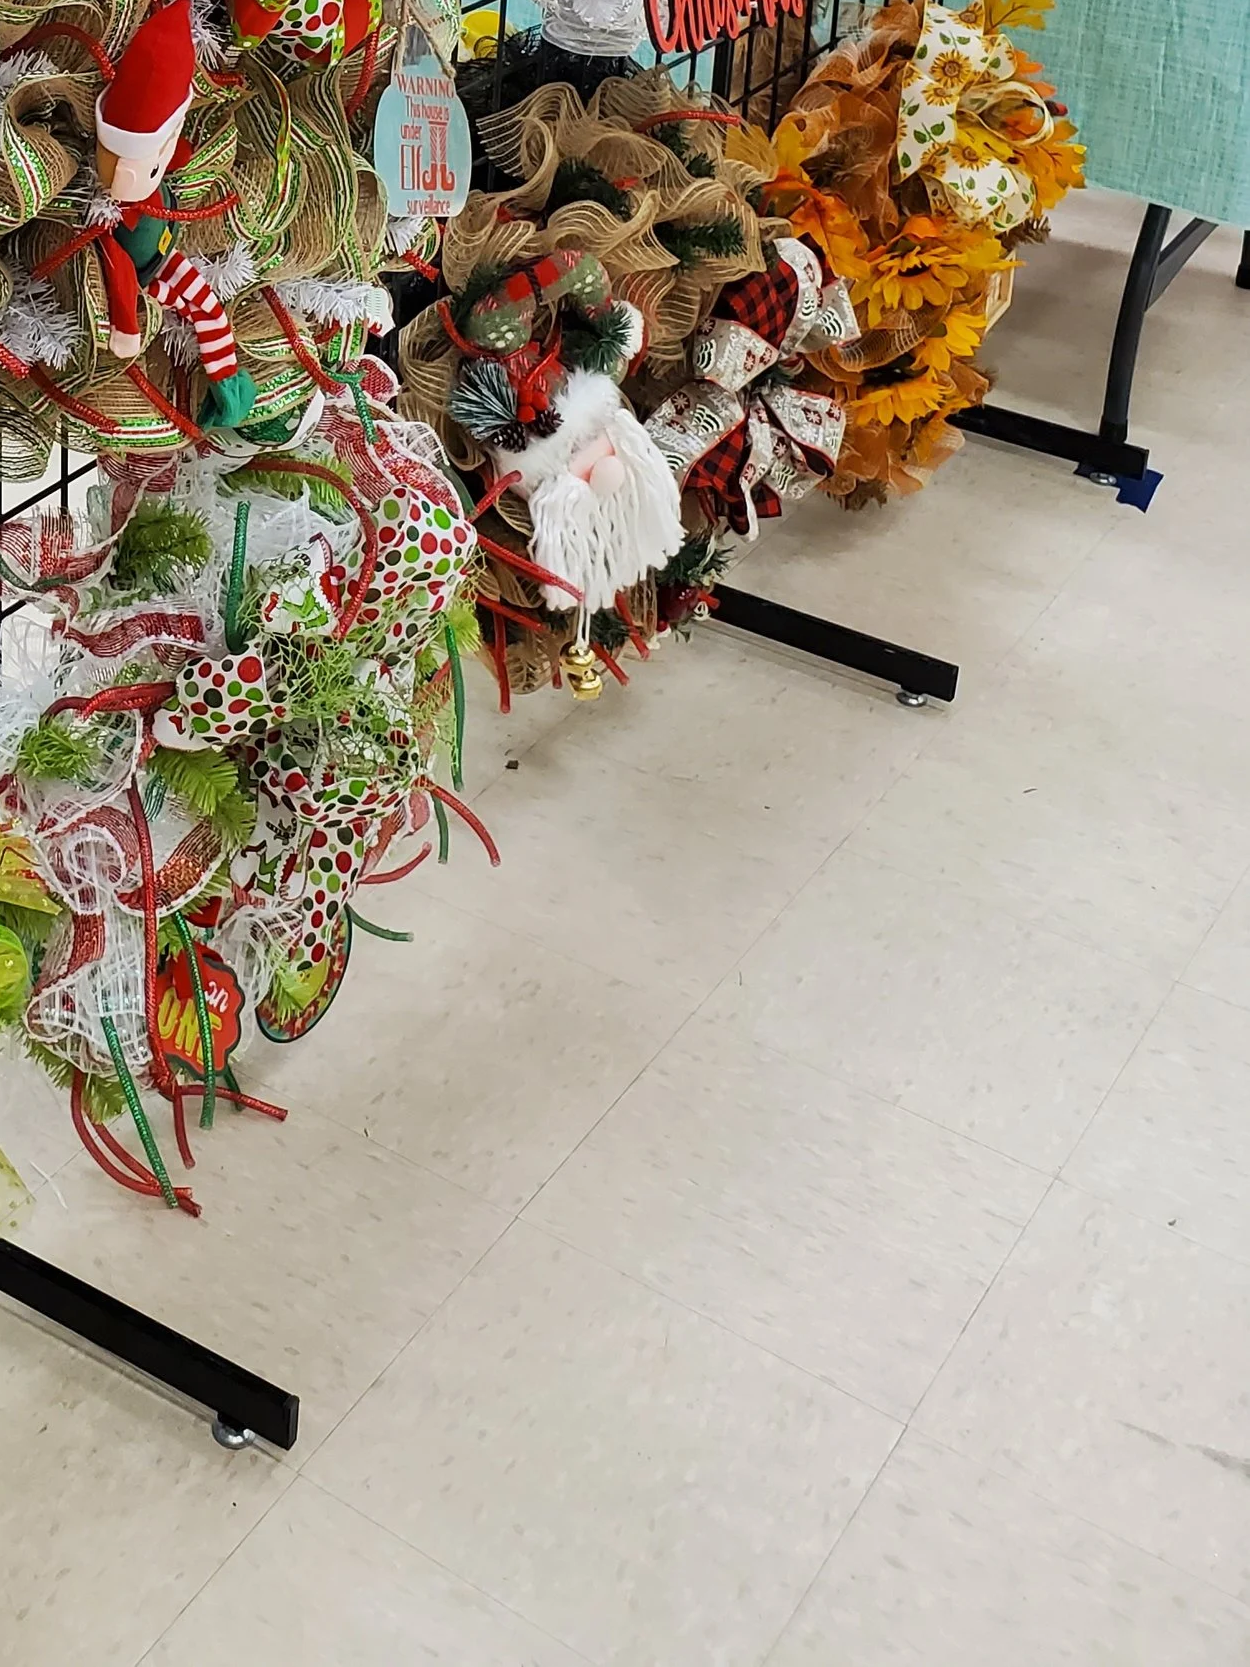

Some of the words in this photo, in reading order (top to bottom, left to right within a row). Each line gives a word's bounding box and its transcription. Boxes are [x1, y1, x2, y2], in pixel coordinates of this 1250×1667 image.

[394, 73, 454, 99] WARNING
[405, 95, 421, 118] This
[421, 98, 443, 121] house
[401, 118, 423, 141] under
[401, 144, 423, 191] Elf
[407, 193, 451, 215] surveillance
